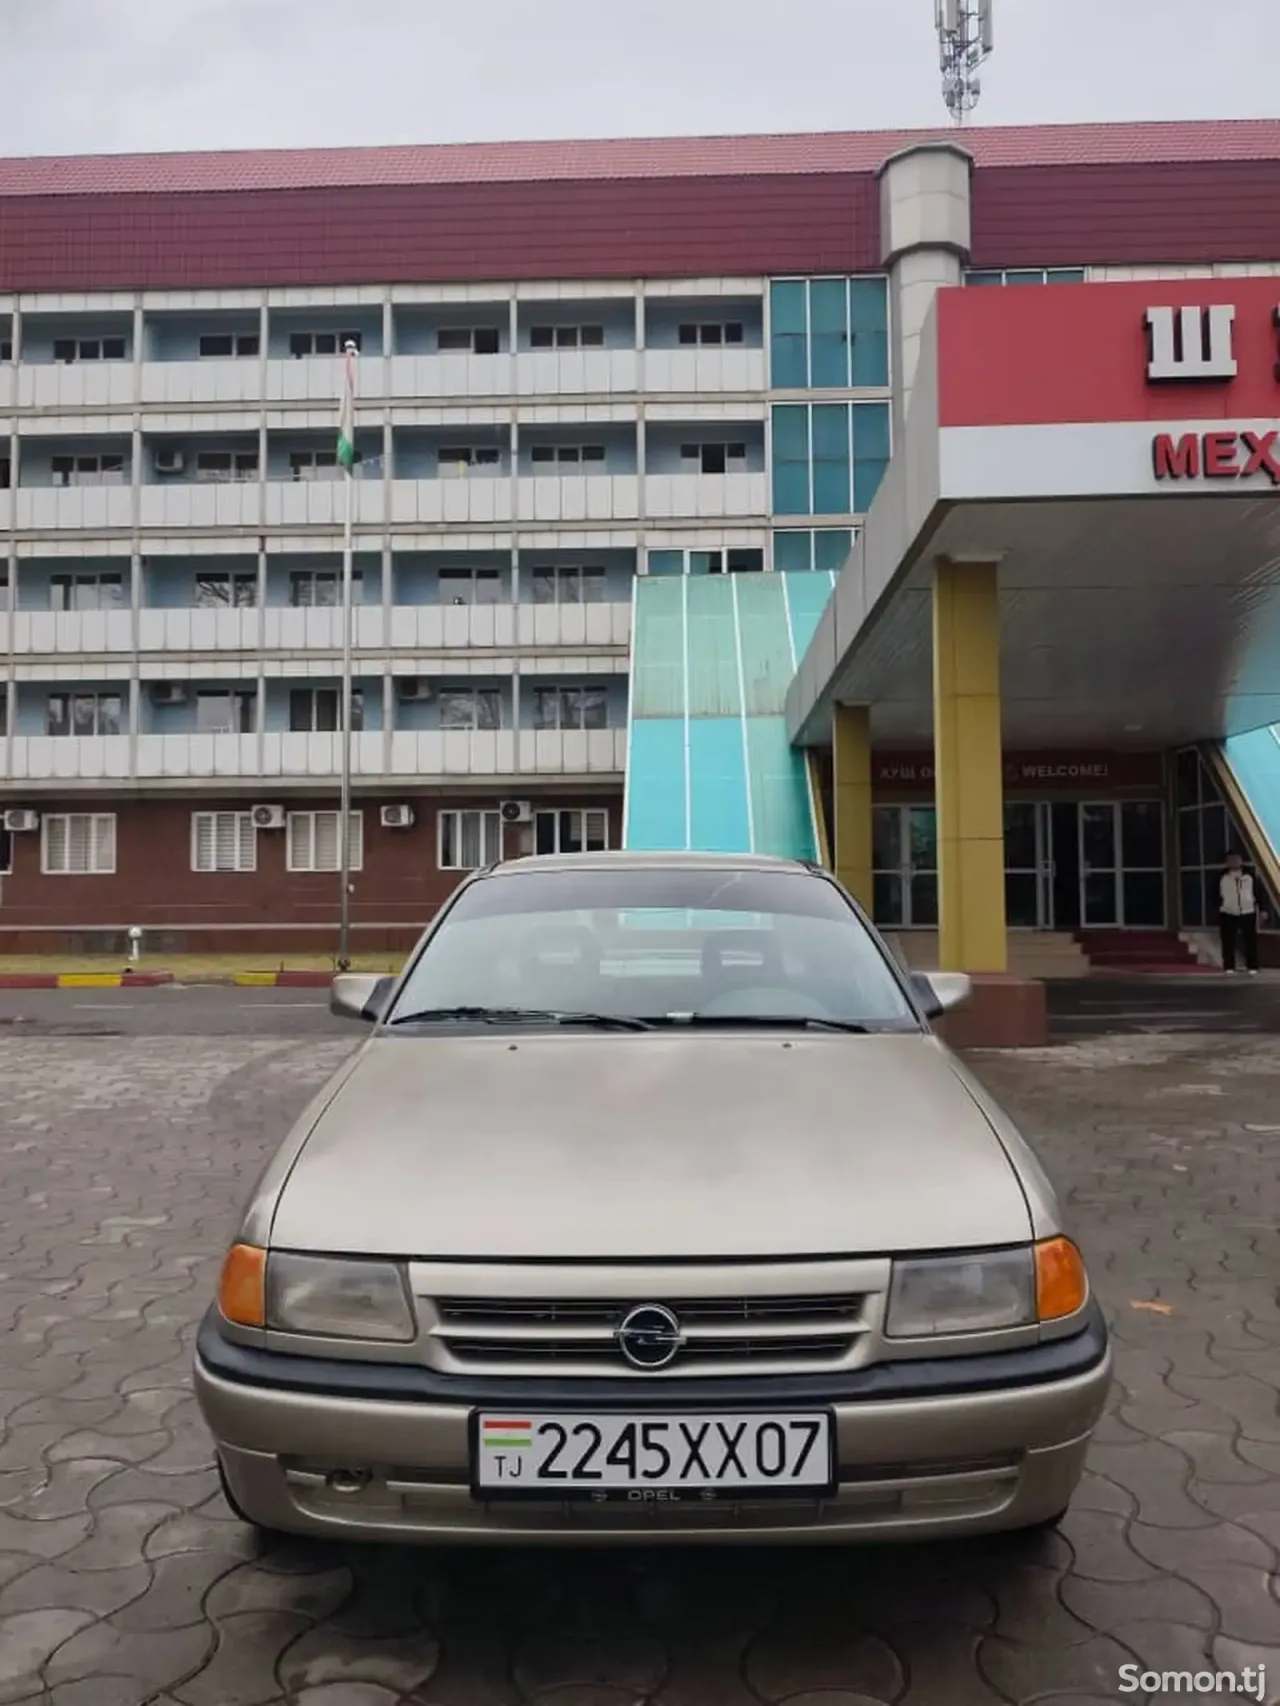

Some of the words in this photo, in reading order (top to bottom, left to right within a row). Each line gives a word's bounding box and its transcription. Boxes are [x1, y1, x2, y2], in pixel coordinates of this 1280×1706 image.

[1145, 304, 1280, 384] Ш
[1022, 763, 1108, 778] WELCOME!
[494, 1455, 521, 1478] TJ
[537, 1421, 821, 1480] 2245XX07
[627, 1490, 681, 1502] OPEL
